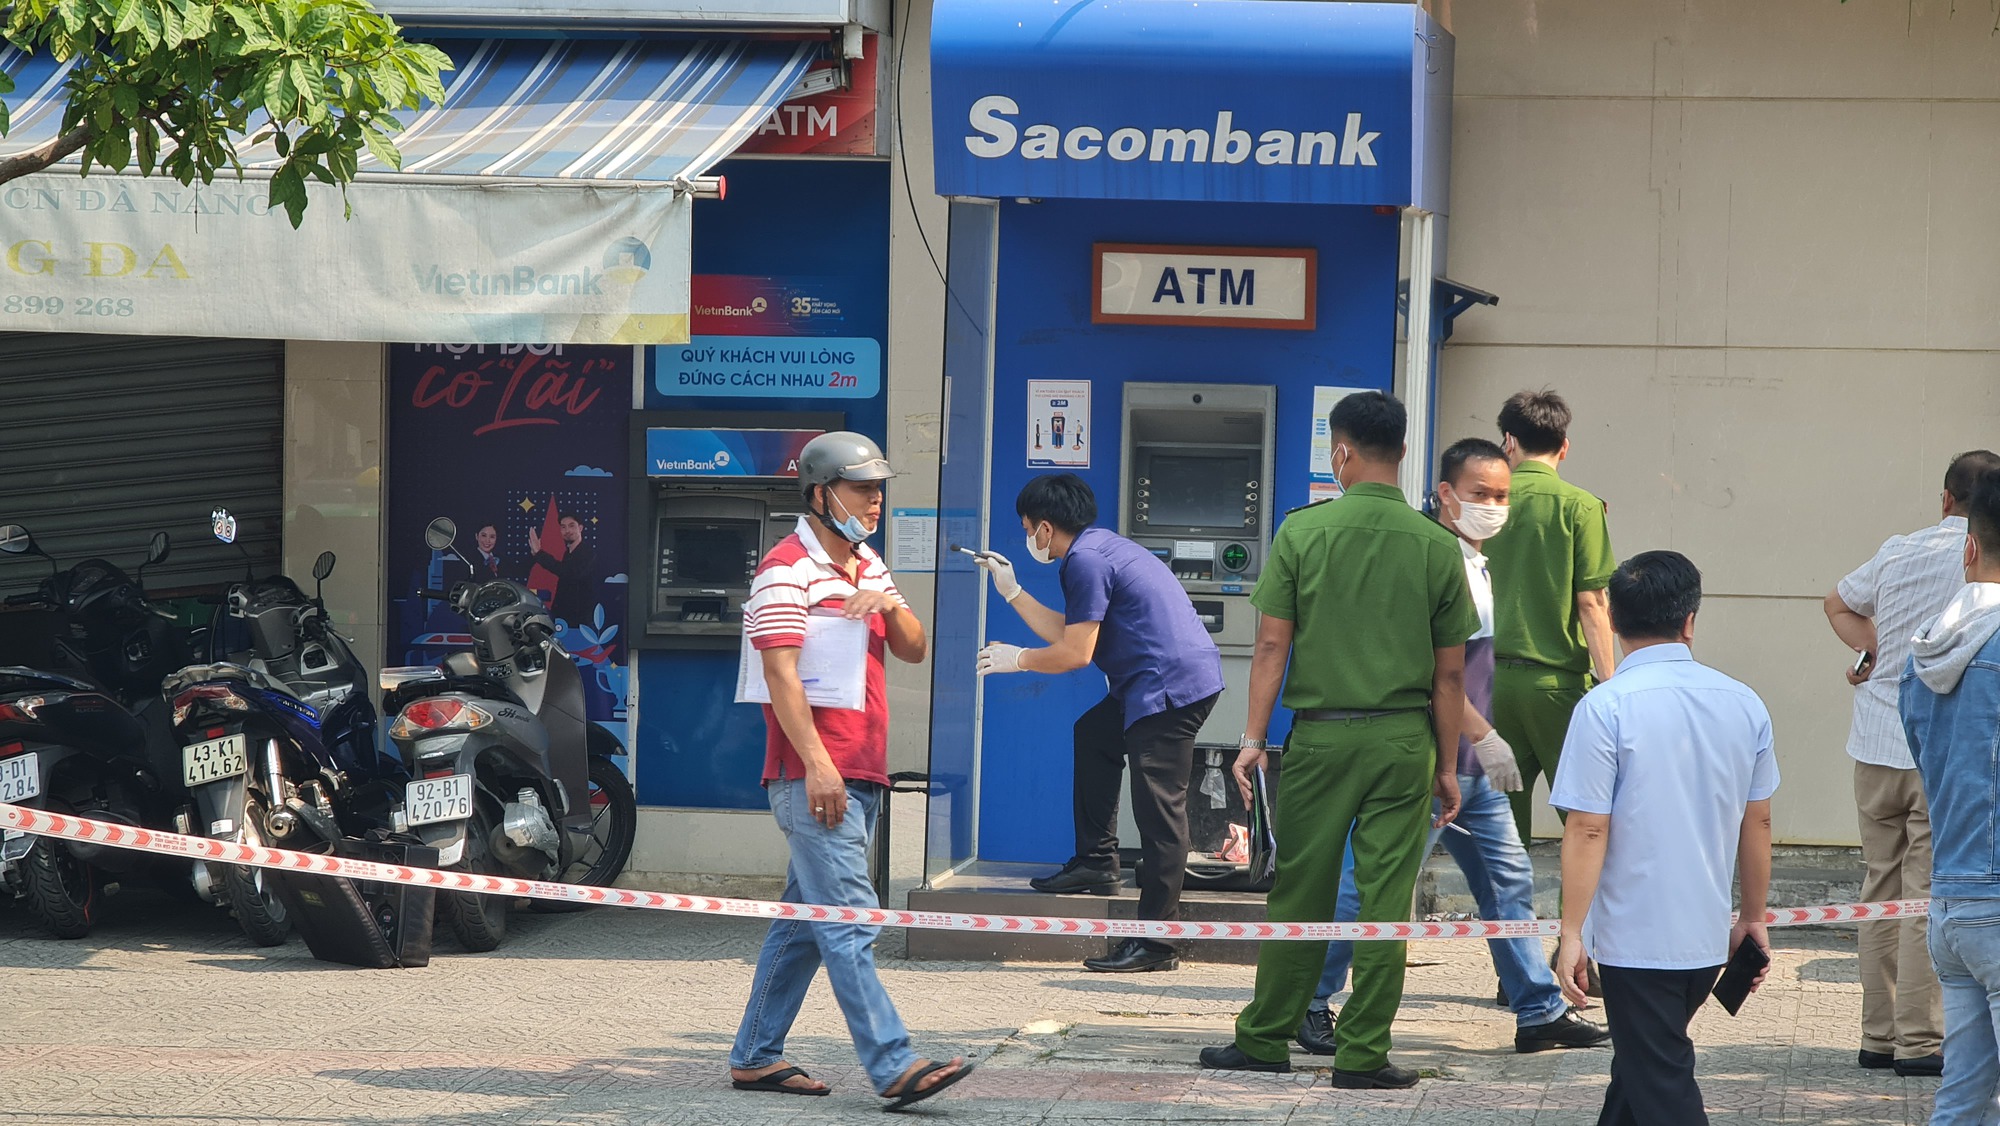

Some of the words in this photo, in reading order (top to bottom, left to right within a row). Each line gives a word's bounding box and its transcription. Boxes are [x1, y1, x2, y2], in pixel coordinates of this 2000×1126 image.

[758, 105, 838, 137] ATM
[964, 95, 1381, 167] Sacombank
[4, 187, 64, 211] CN
[76, 183, 139, 213] ĐÀ
[82, 241, 194, 280] ĐA
[411, 263, 604, 296] VietinBank
[1152, 266, 1255, 306] ATM
[3, 295, 64, 315] 899
[74, 296, 135, 317] 268
[694, 305, 753, 317] VietinBank
[791, 297, 811, 314] 35
[681, 346, 715, 363] QUÝ
[720, 347, 775, 364] KHÁCH
[780, 350, 806, 364] VUI
[810, 348, 856, 365] LÒNG
[678, 369, 726, 386] ĐỨNG
[730, 370, 776, 387] CÁCH
[781, 373, 825, 387] NHAU
[828, 371, 857, 388] 2m
[656, 459, 716, 470] VietinBank
[193, 739, 234, 763] 43-K1
[189, 755, 243, 782] 414.62
[417, 779, 459, 801] 92-B1
[412, 797, 467, 822] 420.76
